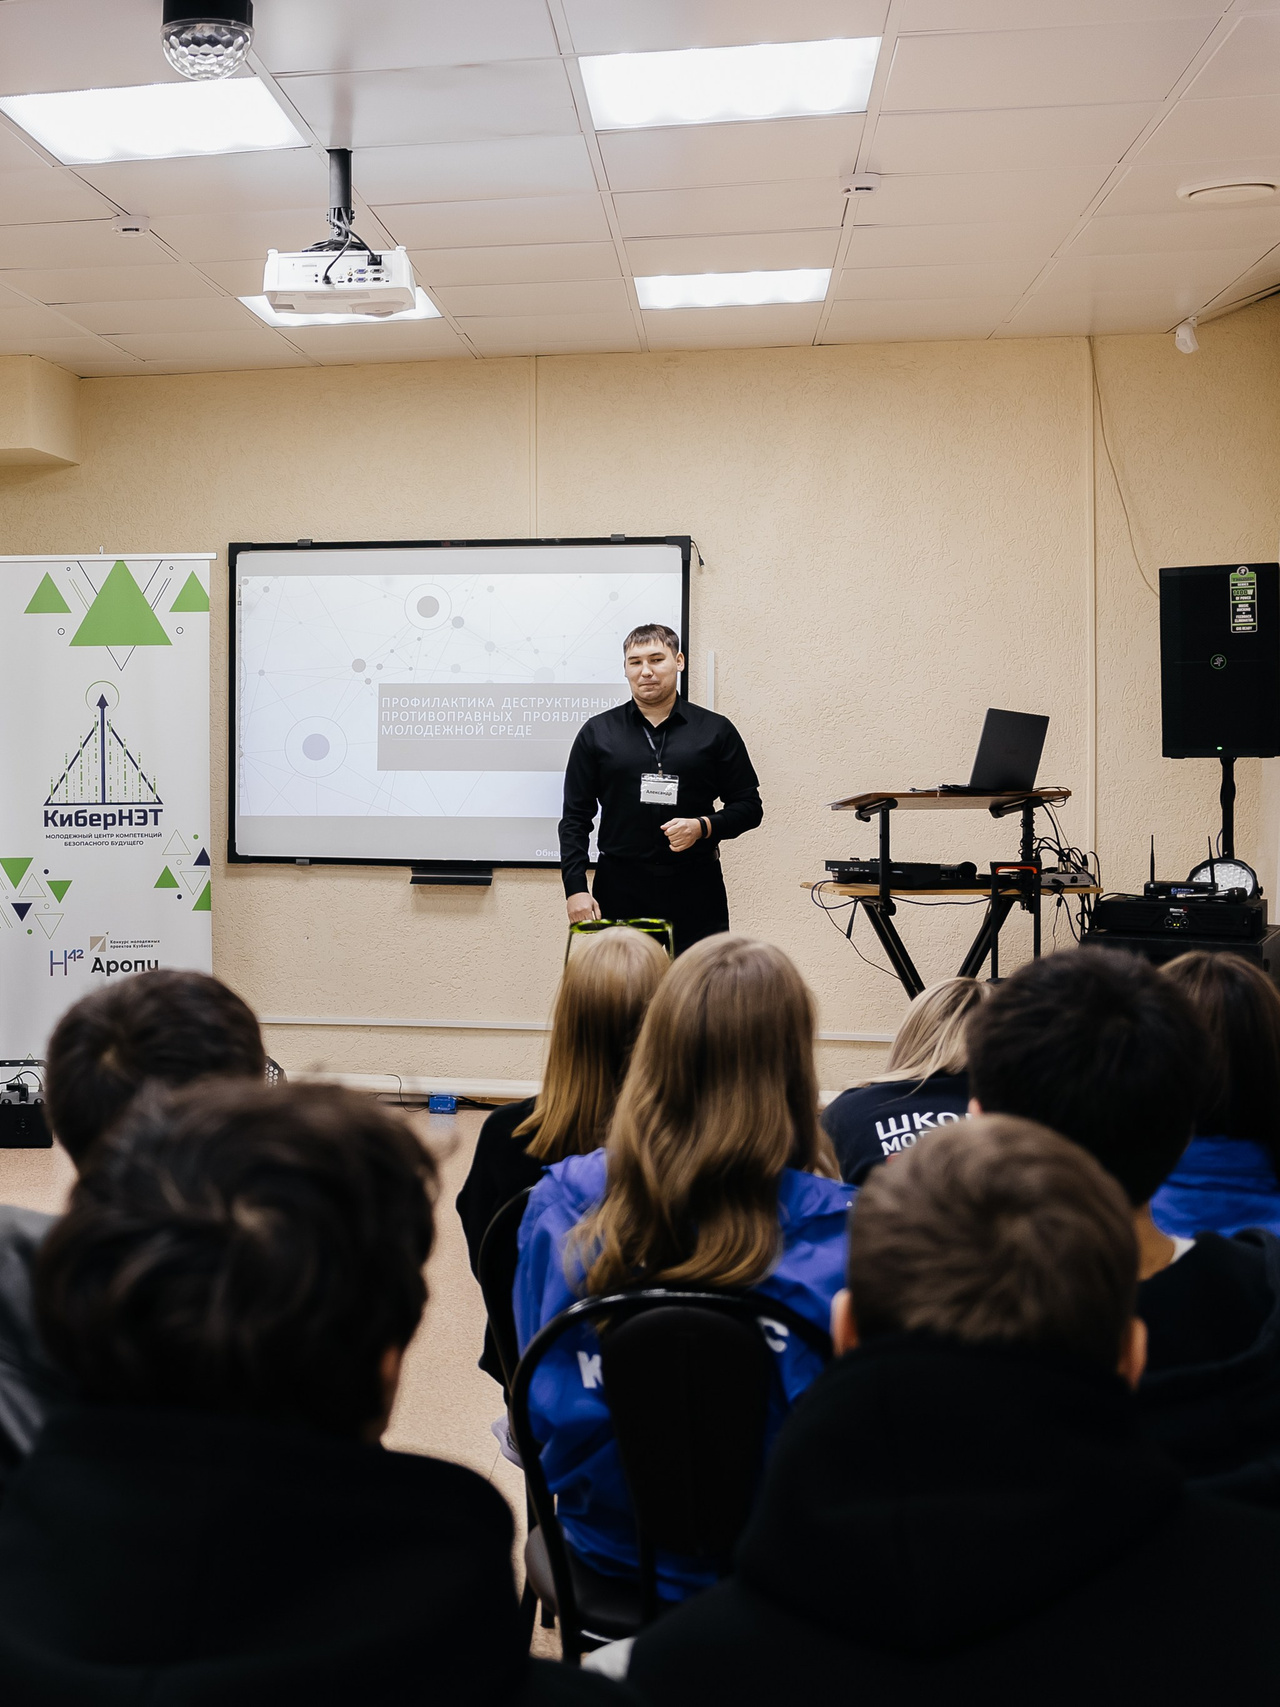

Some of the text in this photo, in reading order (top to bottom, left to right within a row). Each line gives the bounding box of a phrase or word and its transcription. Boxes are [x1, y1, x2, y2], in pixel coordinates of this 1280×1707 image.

[381, 697, 495, 709] ПРОФИЛАКТИКА
[381, 711, 513, 722] ПРОТИВОПРАВНЫХ
[381, 722, 532, 737] МОЛОДЕЖНОЙ СРЕДЕ
[43, 808, 163, 830] КиберНЭТ
